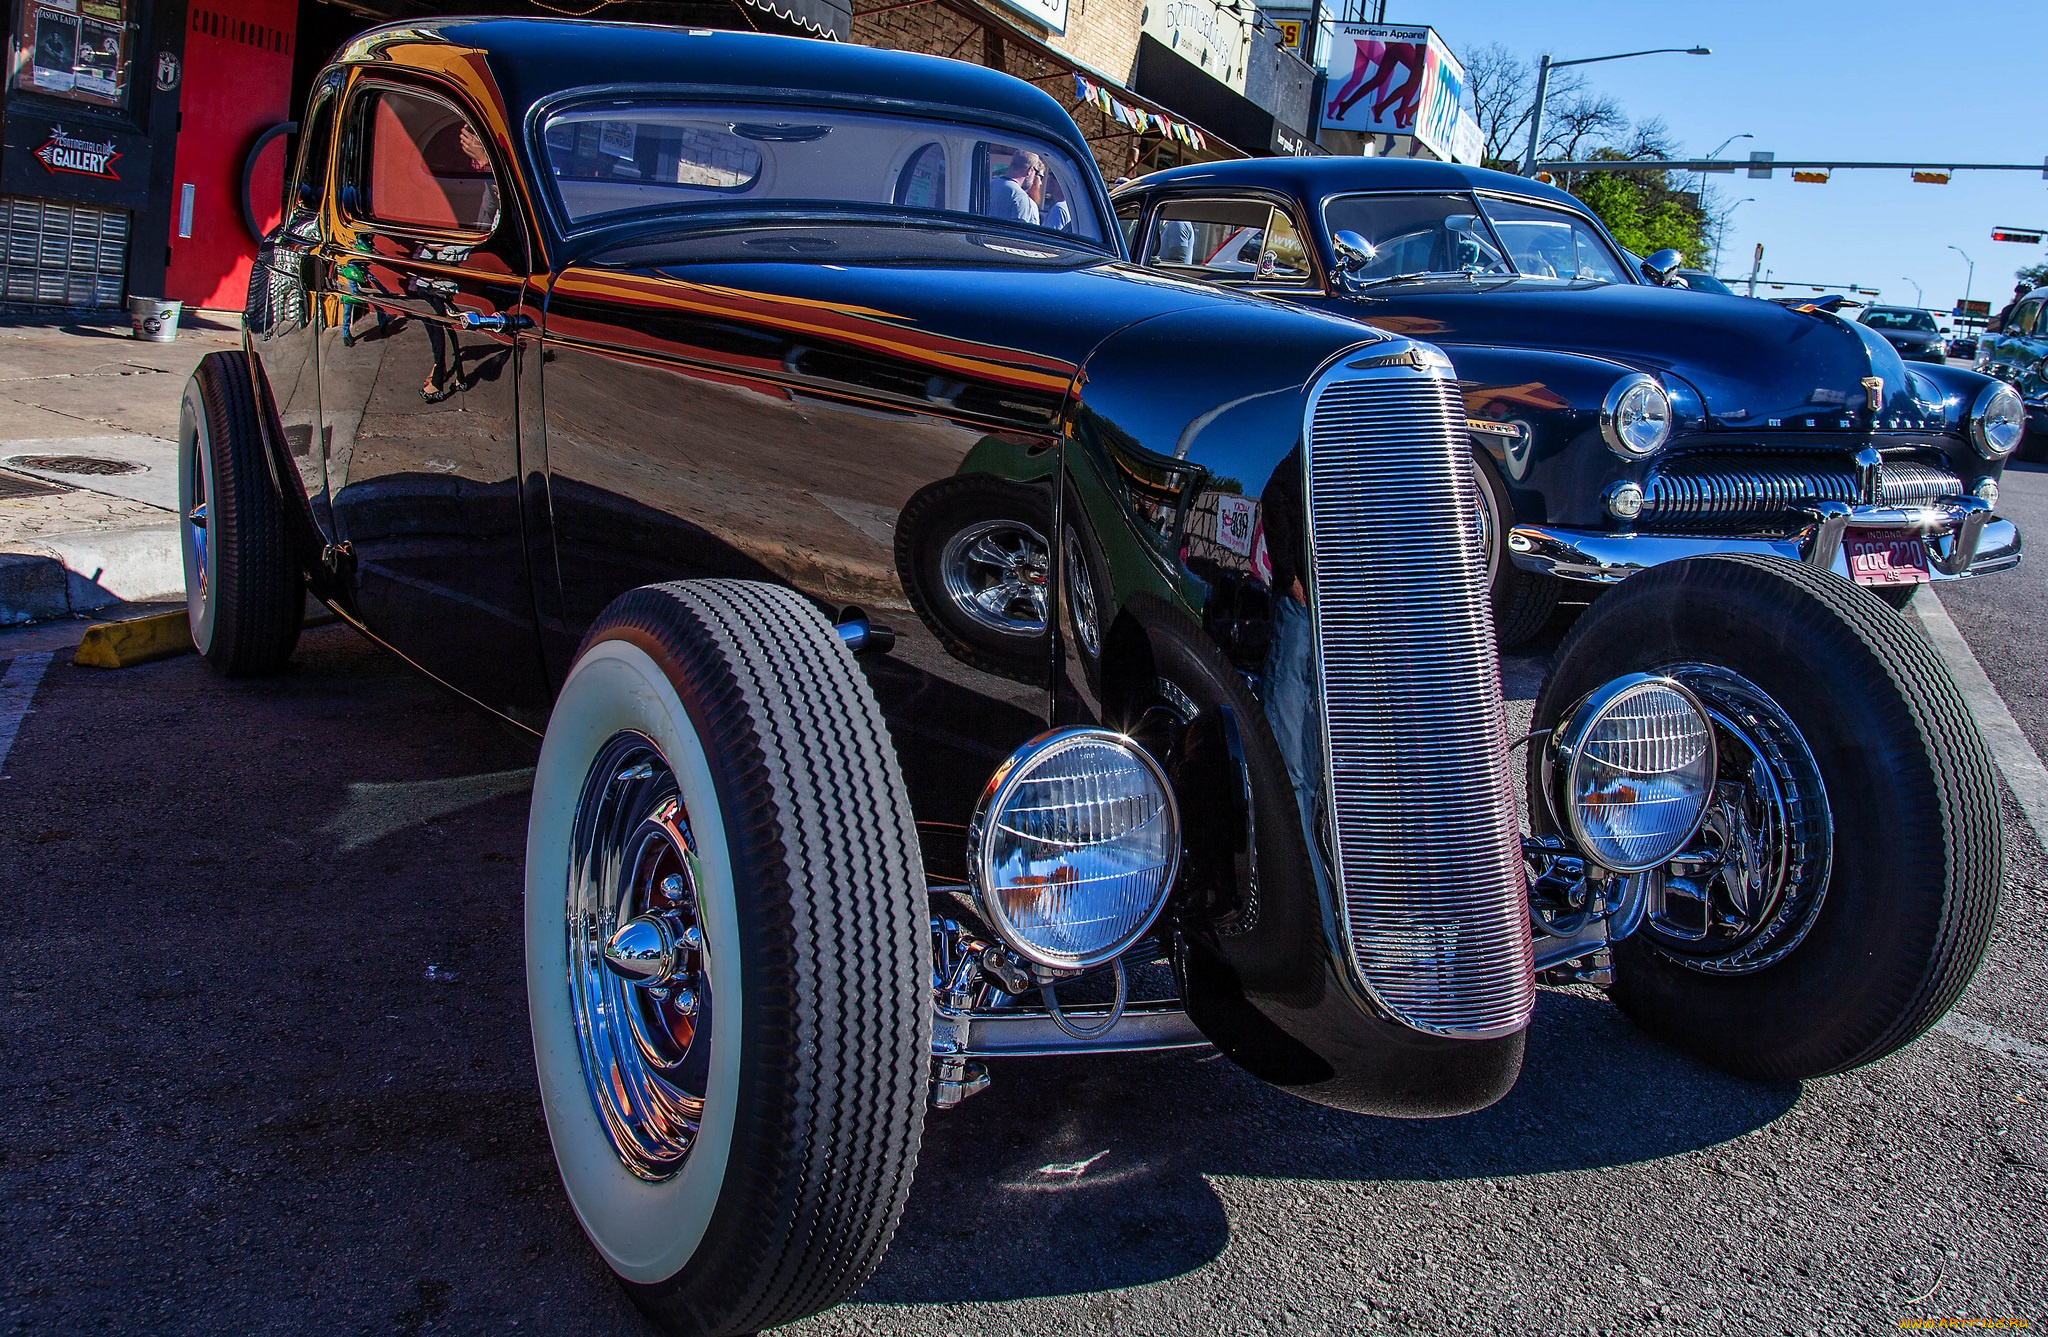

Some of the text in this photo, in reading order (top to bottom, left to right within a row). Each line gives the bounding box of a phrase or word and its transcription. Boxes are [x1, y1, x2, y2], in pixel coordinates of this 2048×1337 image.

[39, 10, 60, 22] JASON
[60, 15, 78, 27] EADY
[1343, 26, 1427, 40] American Apparel
[52, 147, 109, 173] GALLERY
[1867, 530, 1902, 540] INDIANA
[1889, 540, 1923, 569] 220
